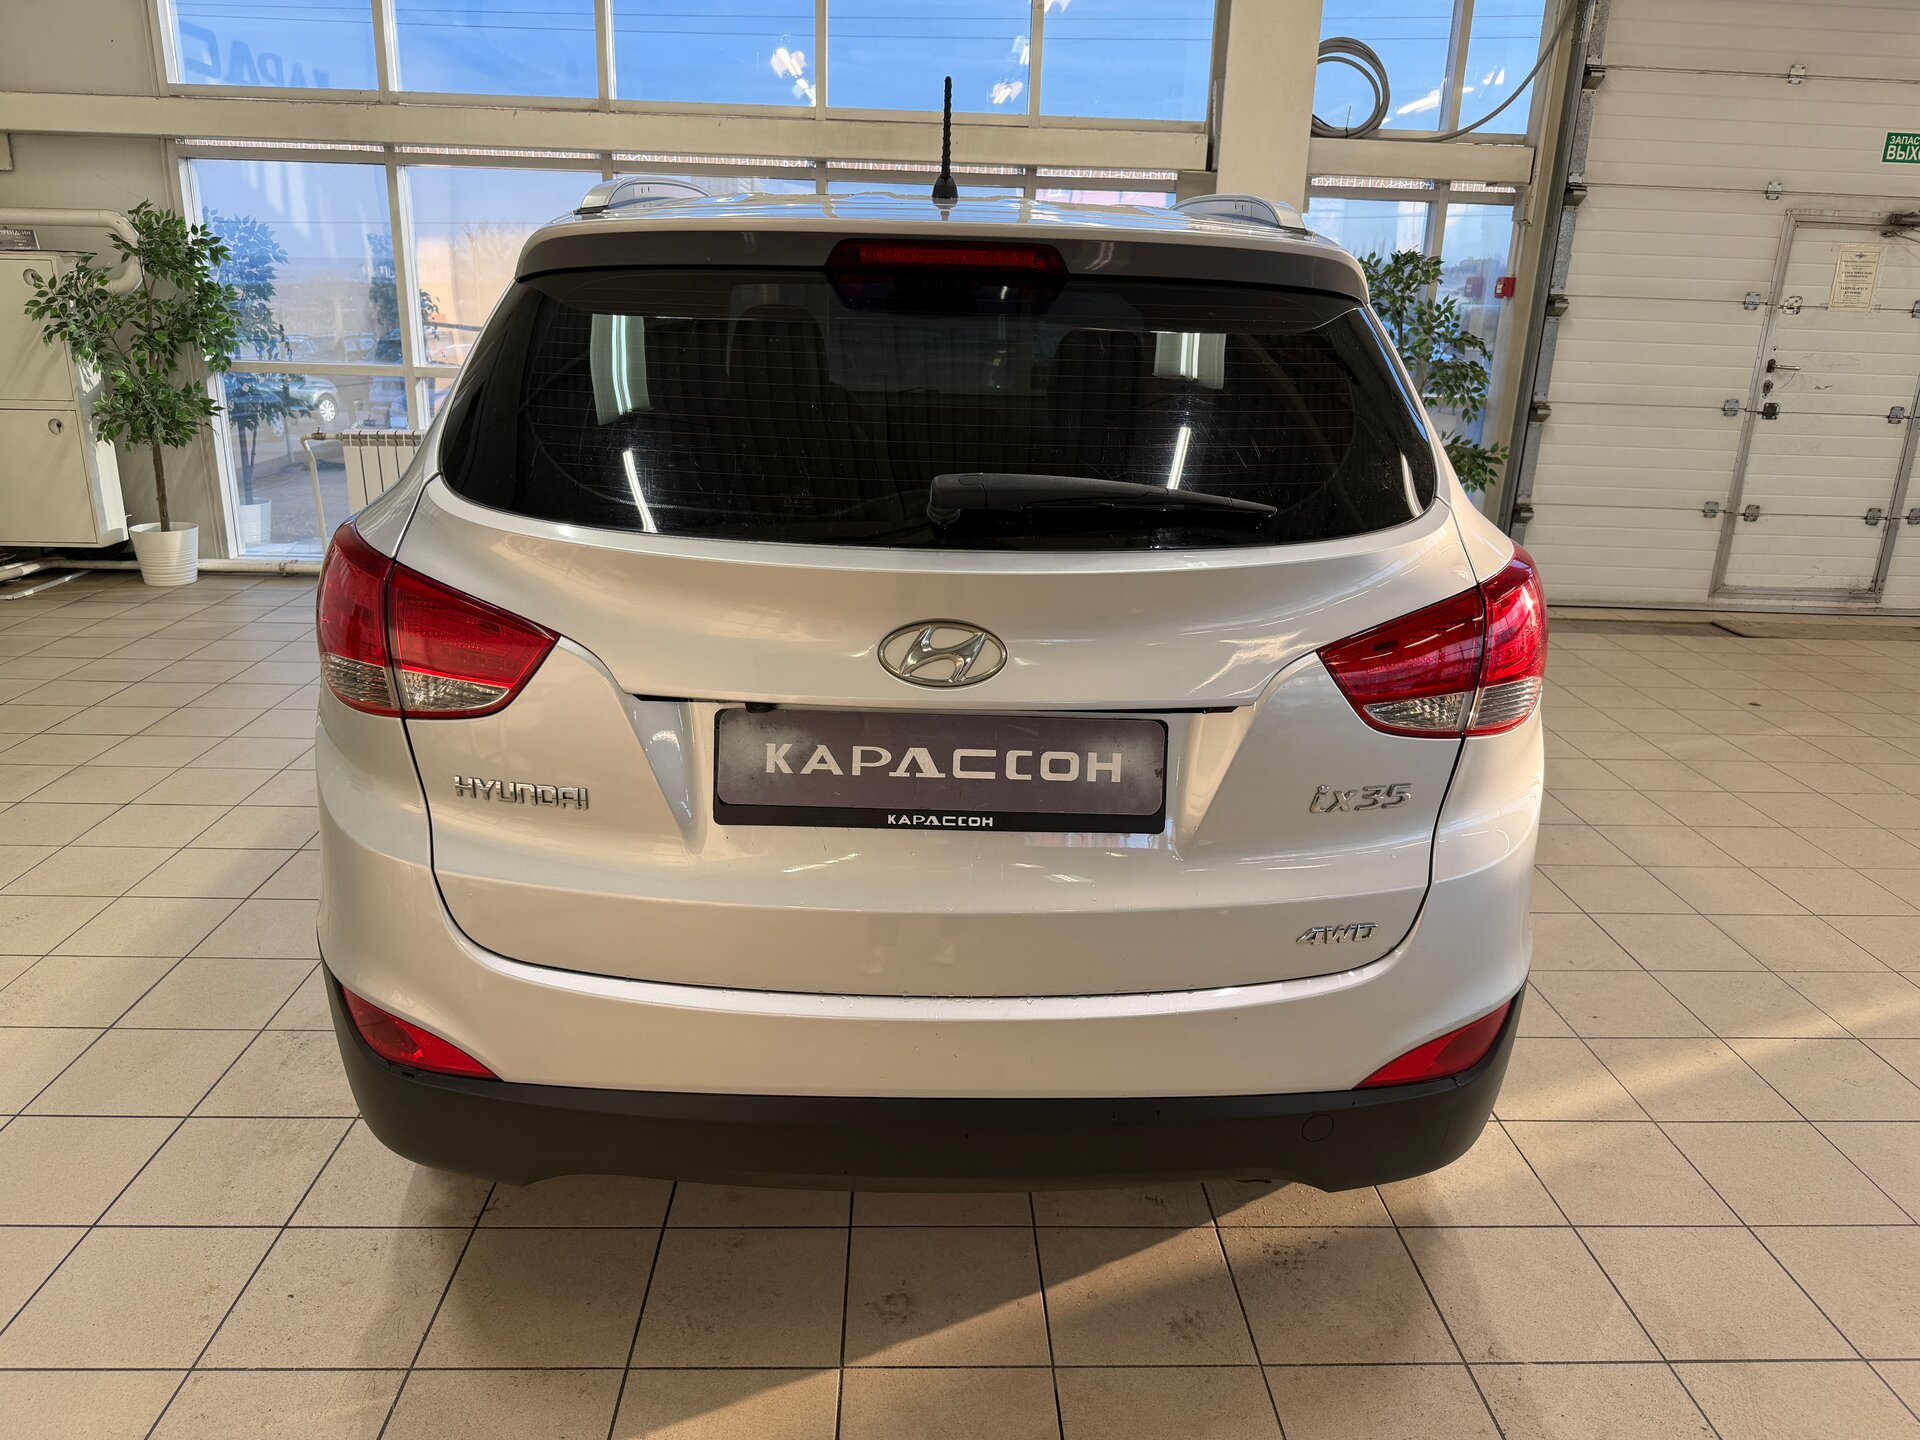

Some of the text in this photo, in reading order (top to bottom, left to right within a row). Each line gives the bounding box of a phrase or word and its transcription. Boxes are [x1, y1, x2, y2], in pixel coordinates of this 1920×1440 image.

[1886, 145, 1920, 161] ВЫХ
[453, 774, 589, 811] HYUNDAI
[1309, 783, 1413, 815] ix35
[1296, 922, 1379, 946] 4WD
